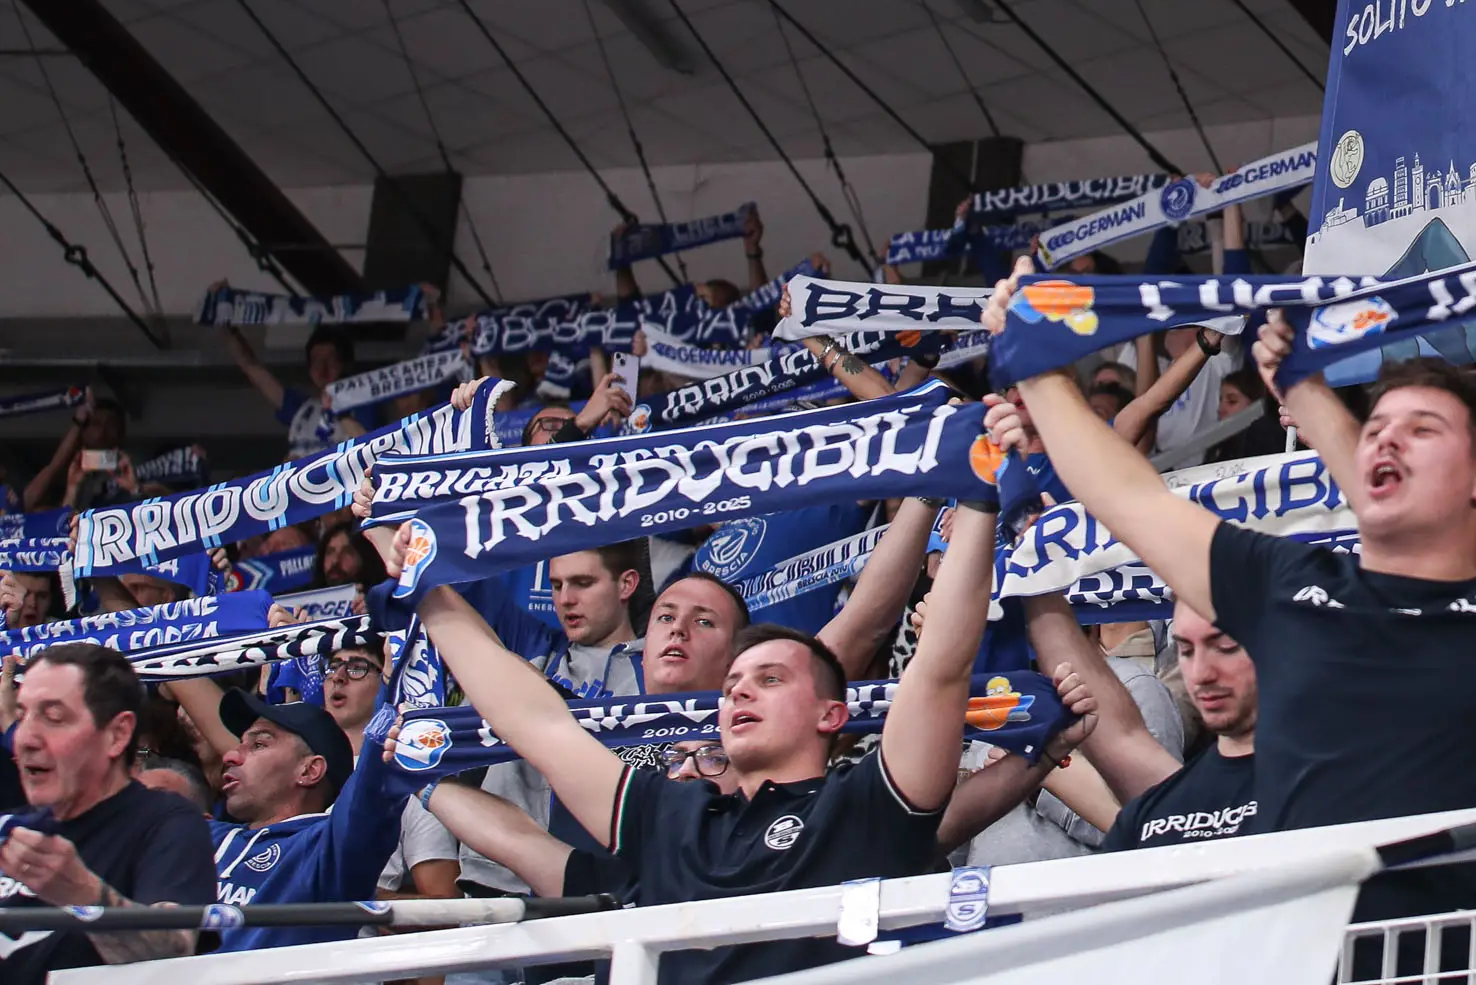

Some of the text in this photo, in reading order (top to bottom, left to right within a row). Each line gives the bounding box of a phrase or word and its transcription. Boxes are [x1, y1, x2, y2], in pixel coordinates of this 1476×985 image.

[1075, 200, 1147, 242] GERMANI
[676, 342, 752, 366] GERMANI
[371, 458, 572, 504] BRIGATA
[459, 404, 959, 560] IRRIDUCIBILI
[641, 507, 689, 527] 2010
[703, 496, 752, 515] 2025
[702, 551, 749, 580] BRESCIA
[129, 620, 220, 651] FORZA
[641, 725, 689, 739] 2010
